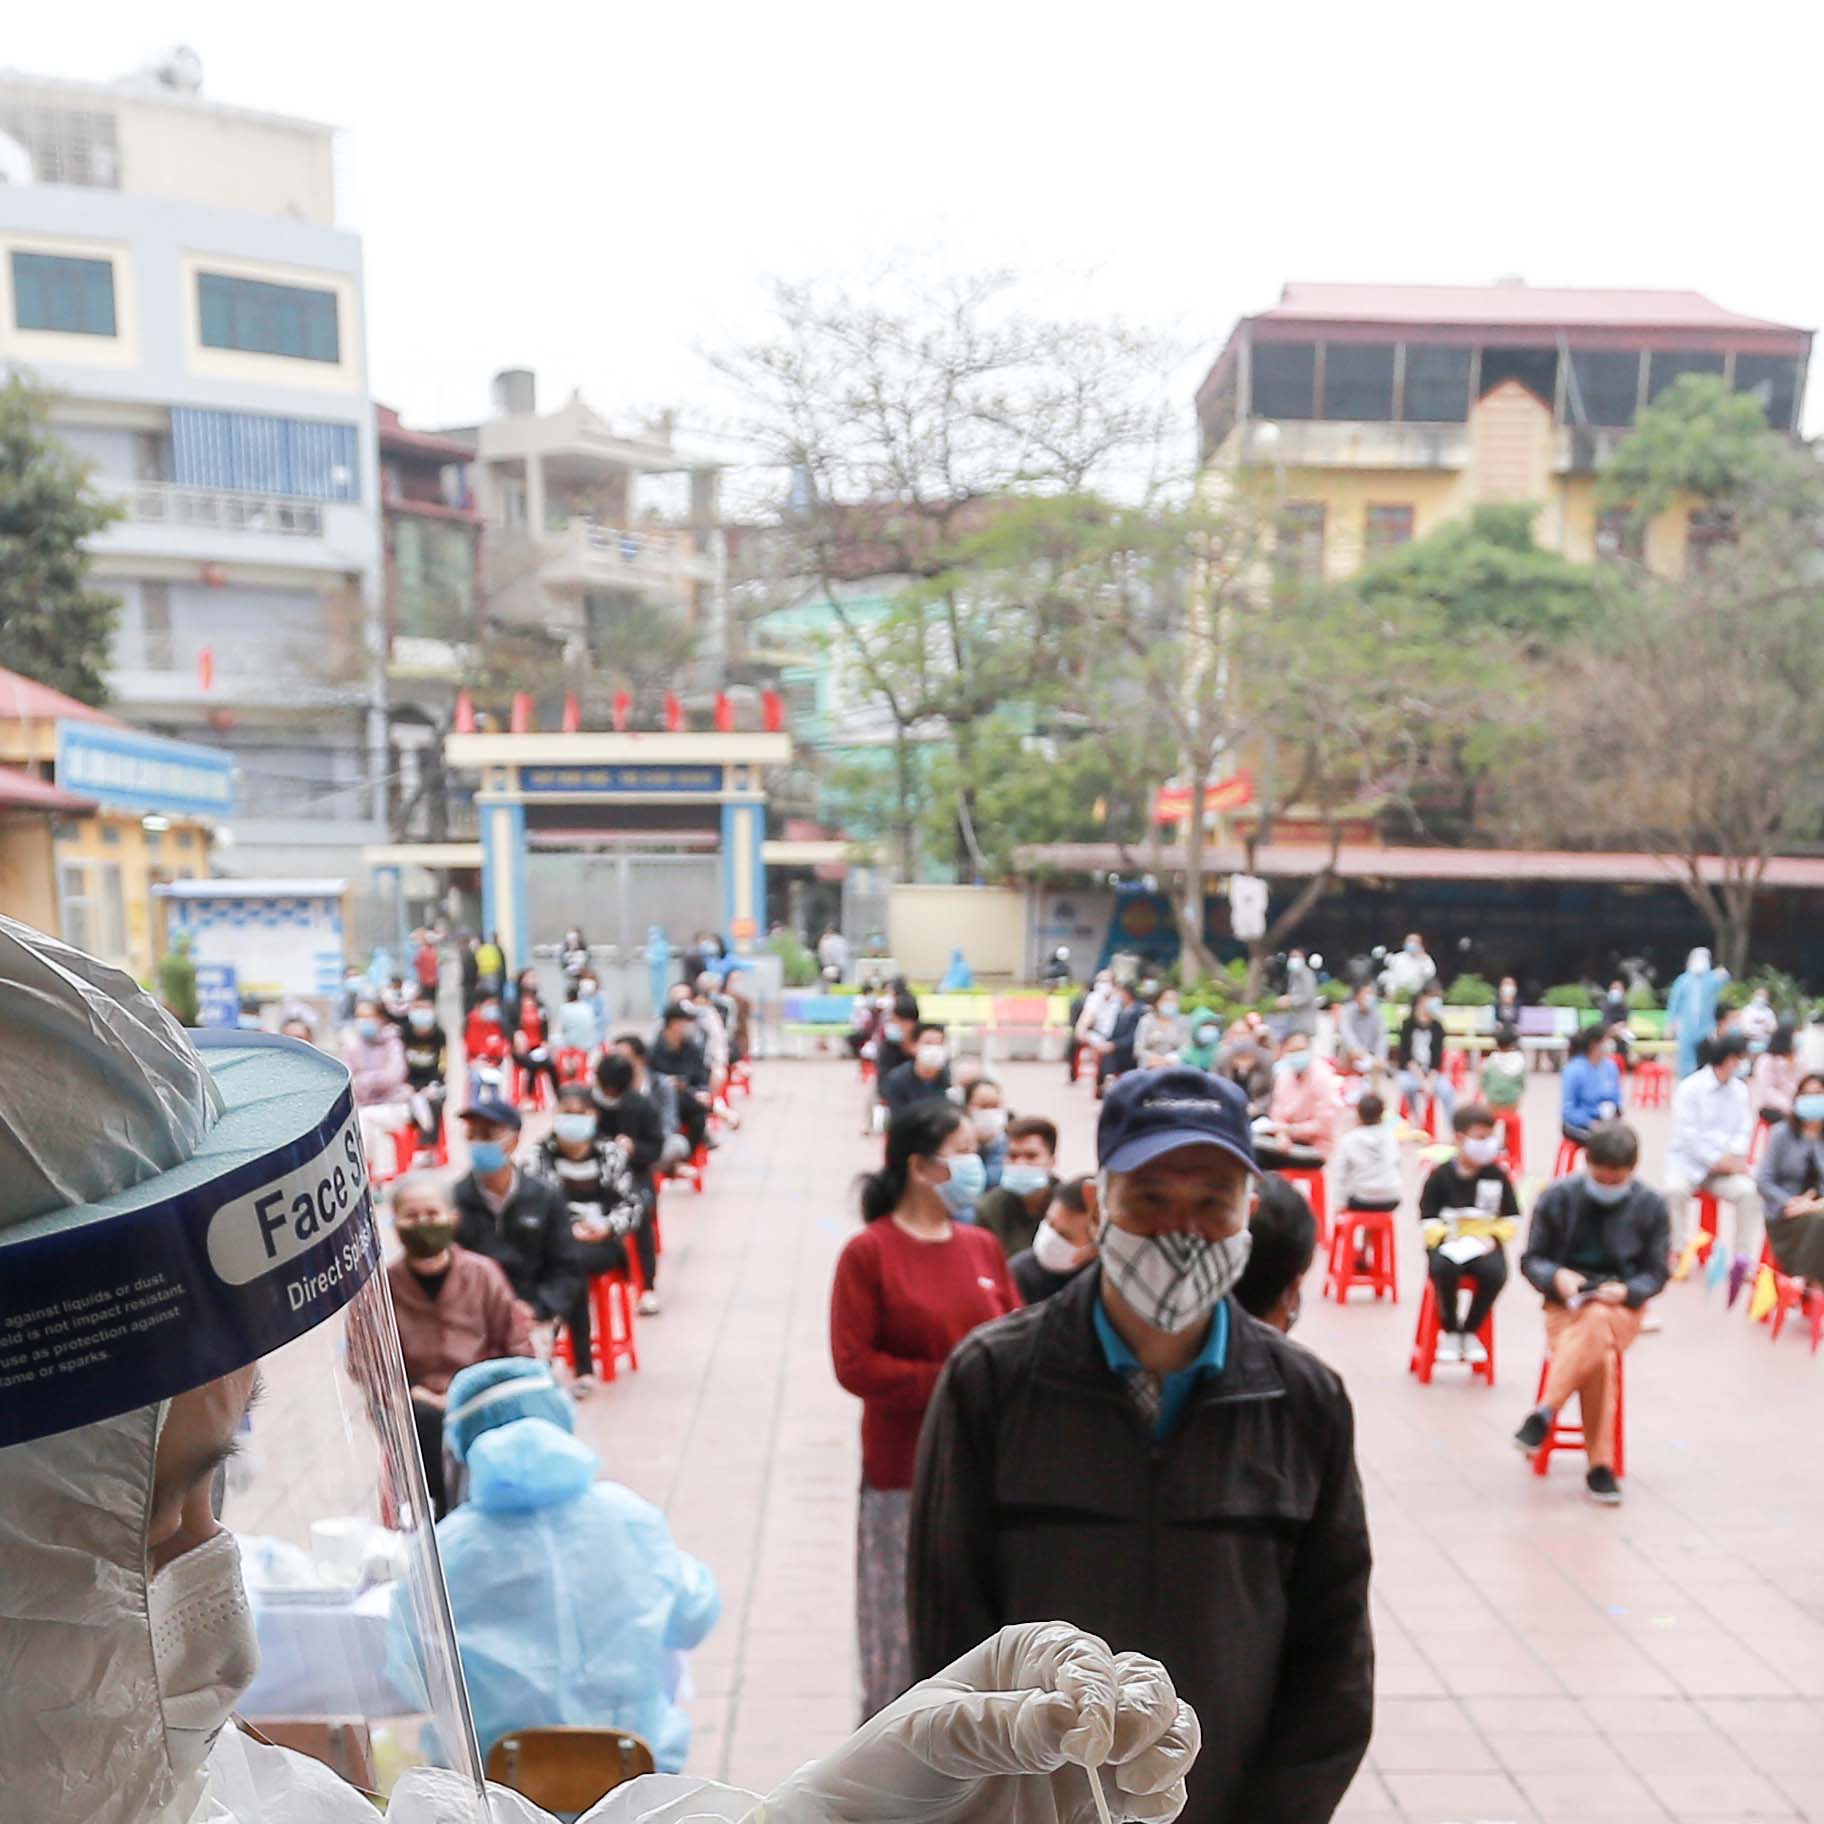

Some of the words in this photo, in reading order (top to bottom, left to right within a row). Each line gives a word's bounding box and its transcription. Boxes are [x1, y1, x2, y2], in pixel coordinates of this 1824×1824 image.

[255, 1164, 348, 1258] Face
[4, 1304, 61, 1328] against
[62, 1291, 112, 1311] liquids
[116, 1287, 130, 1297] or
[134, 1273, 166, 1291] dust
[287, 1260, 344, 1311] Direct
[0, 1352, 28, 1369] use
[32, 1349, 49, 1361] as
[53, 1325, 128, 1356] protection
[130, 1306, 182, 1333] against
[28, 1328, 40, 1340] is
[45, 1321, 69, 1335] not
[72, 1307, 122, 1328] impact
[40, 1366, 55, 1377] or
[59, 1349, 112, 1372] sparks.
